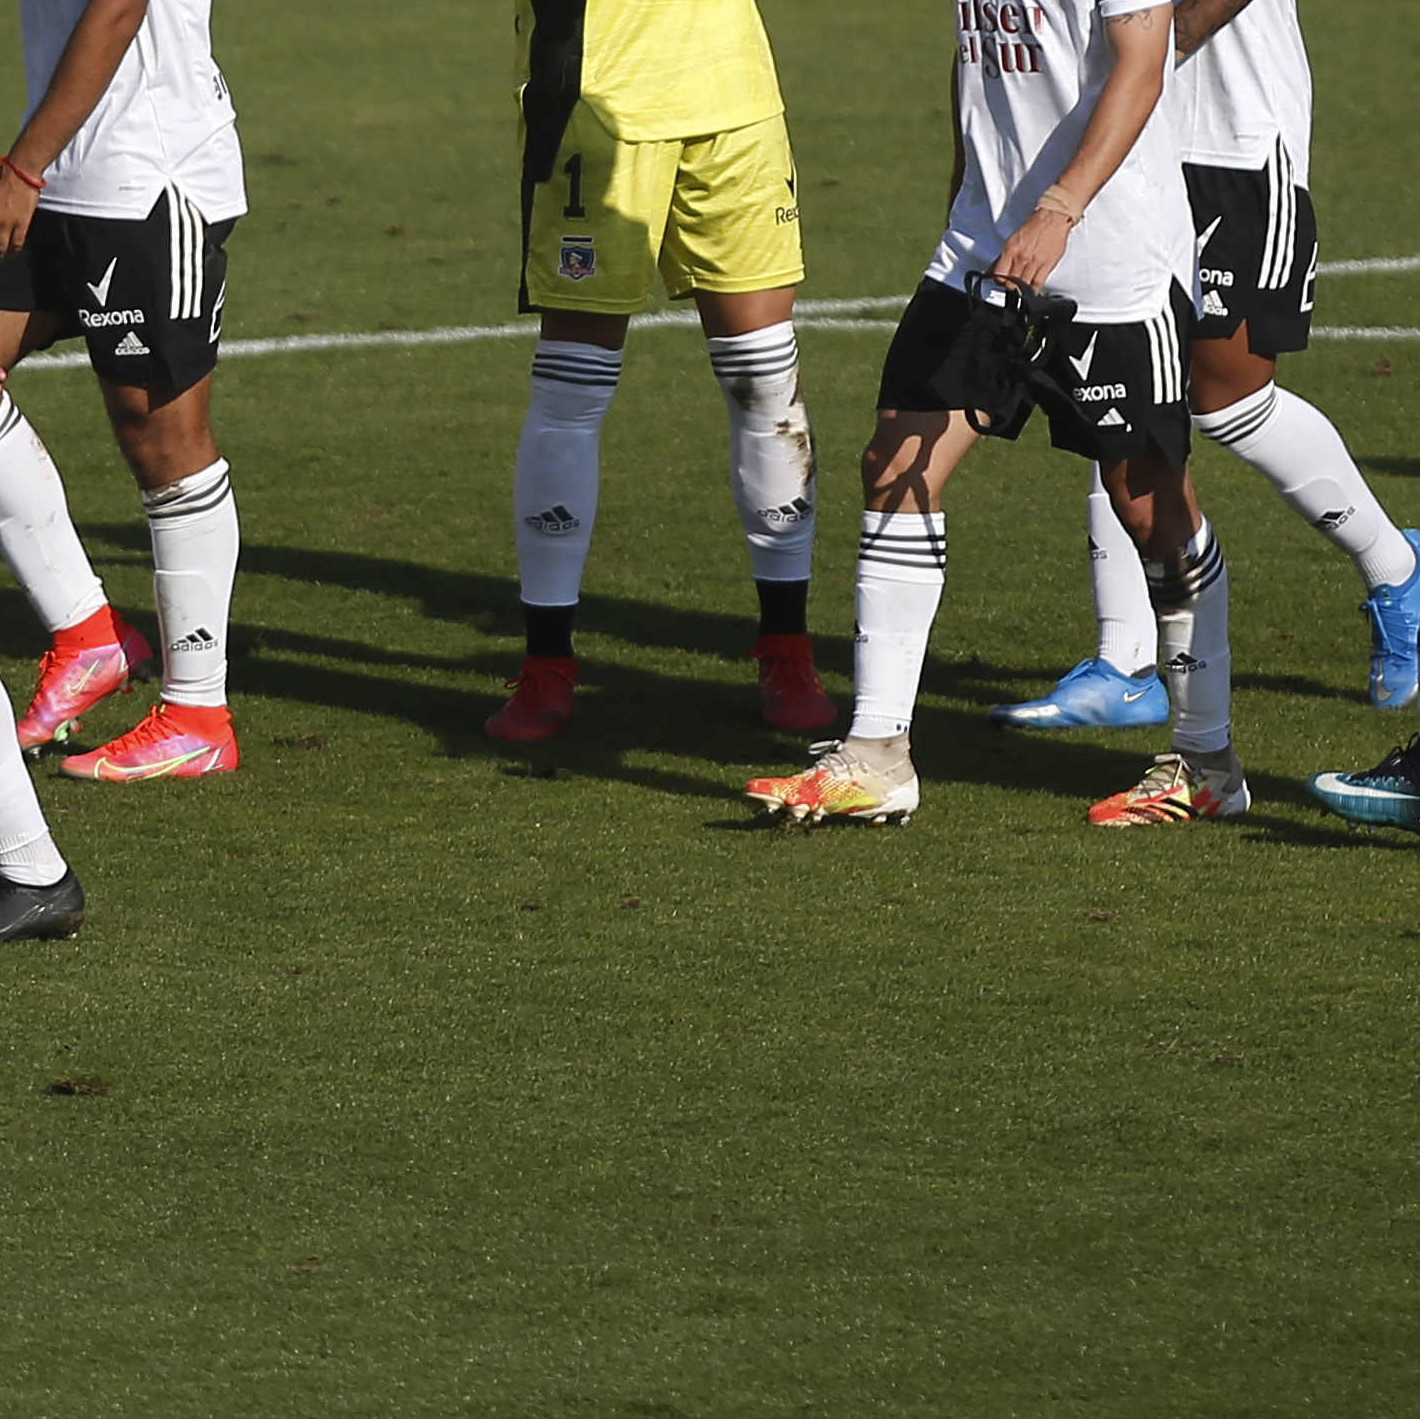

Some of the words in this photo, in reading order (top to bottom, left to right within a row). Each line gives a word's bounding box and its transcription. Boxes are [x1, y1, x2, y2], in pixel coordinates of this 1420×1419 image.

[982, 36, 1044, 79] Sur
[564, 152, 586, 219] 1
[1198, 267, 1235, 287] ona
[78, 308, 145, 329] Rexona
[1073, 383, 1127, 402] exona
[170, 638, 219, 652] adidas
